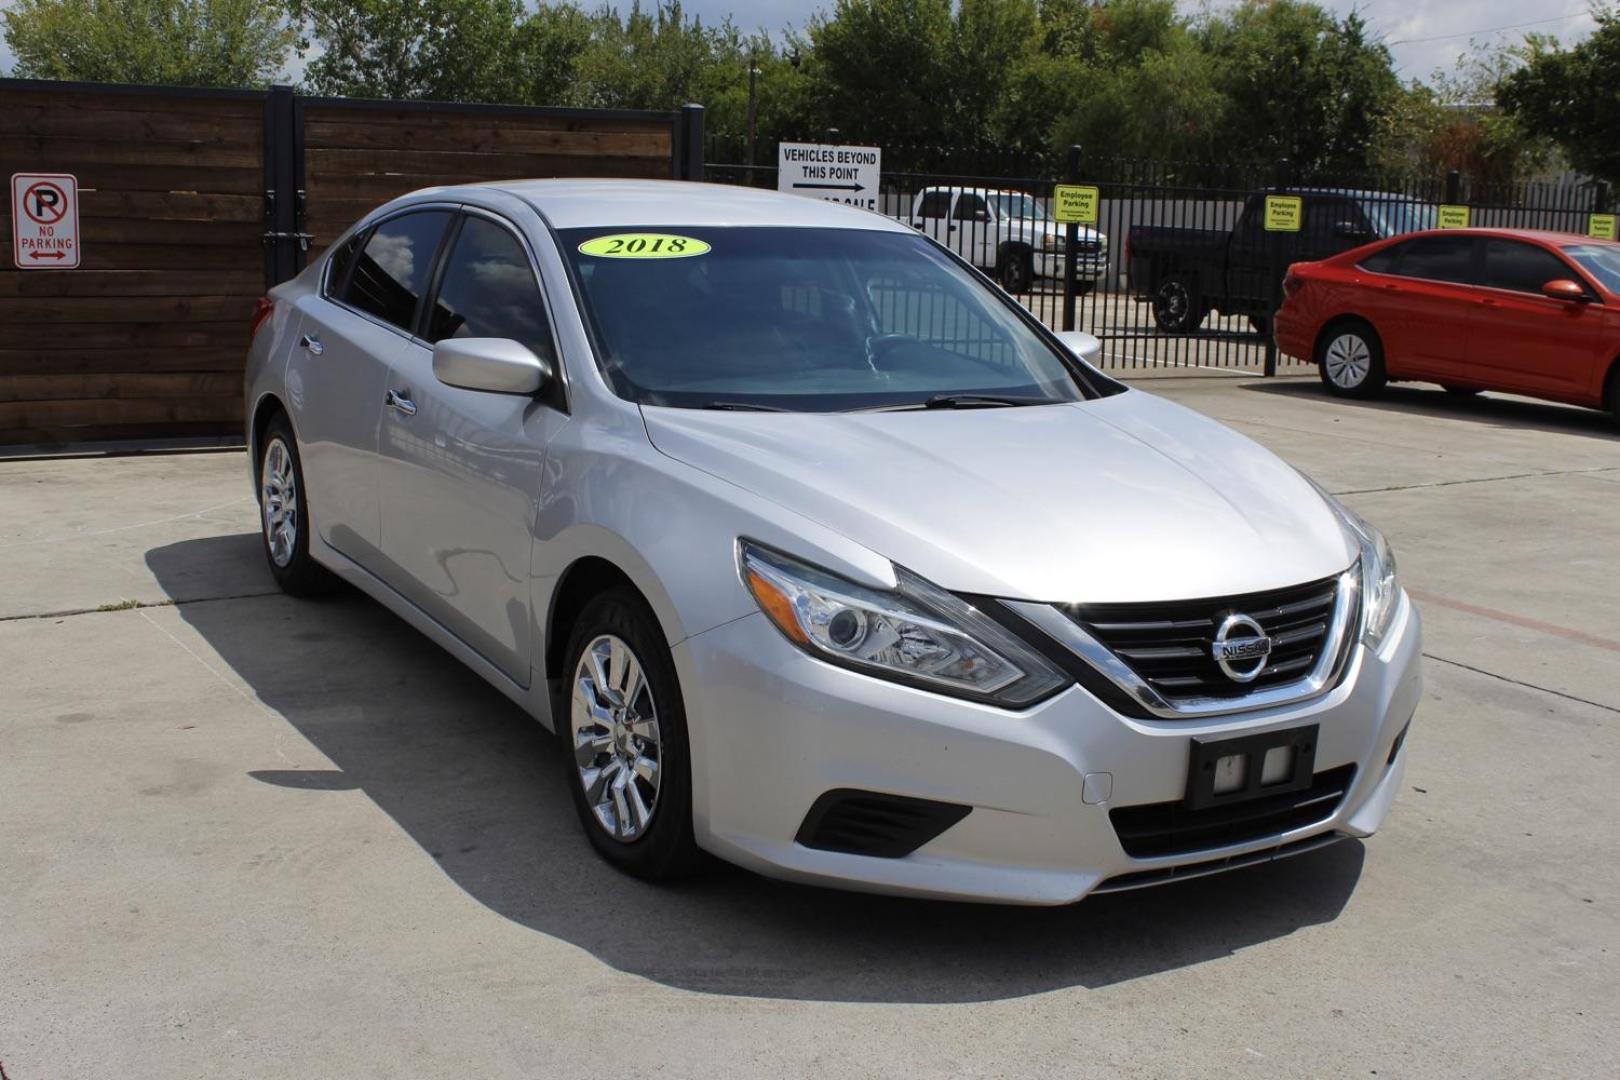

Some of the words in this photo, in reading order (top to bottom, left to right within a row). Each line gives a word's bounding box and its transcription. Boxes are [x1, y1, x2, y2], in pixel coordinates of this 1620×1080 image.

[784, 148, 835, 163] VEHICLES
[837, 151, 877, 165] BEYOND
[802, 166, 826, 179] THIS
[829, 167, 859, 180] POINT
[1060, 190, 1093, 200] Employee
[1063, 199, 1089, 209] Parking
[39, 226, 54, 237] NO
[22, 238, 72, 249] PARKING
[605, 238, 687, 254] 2018
